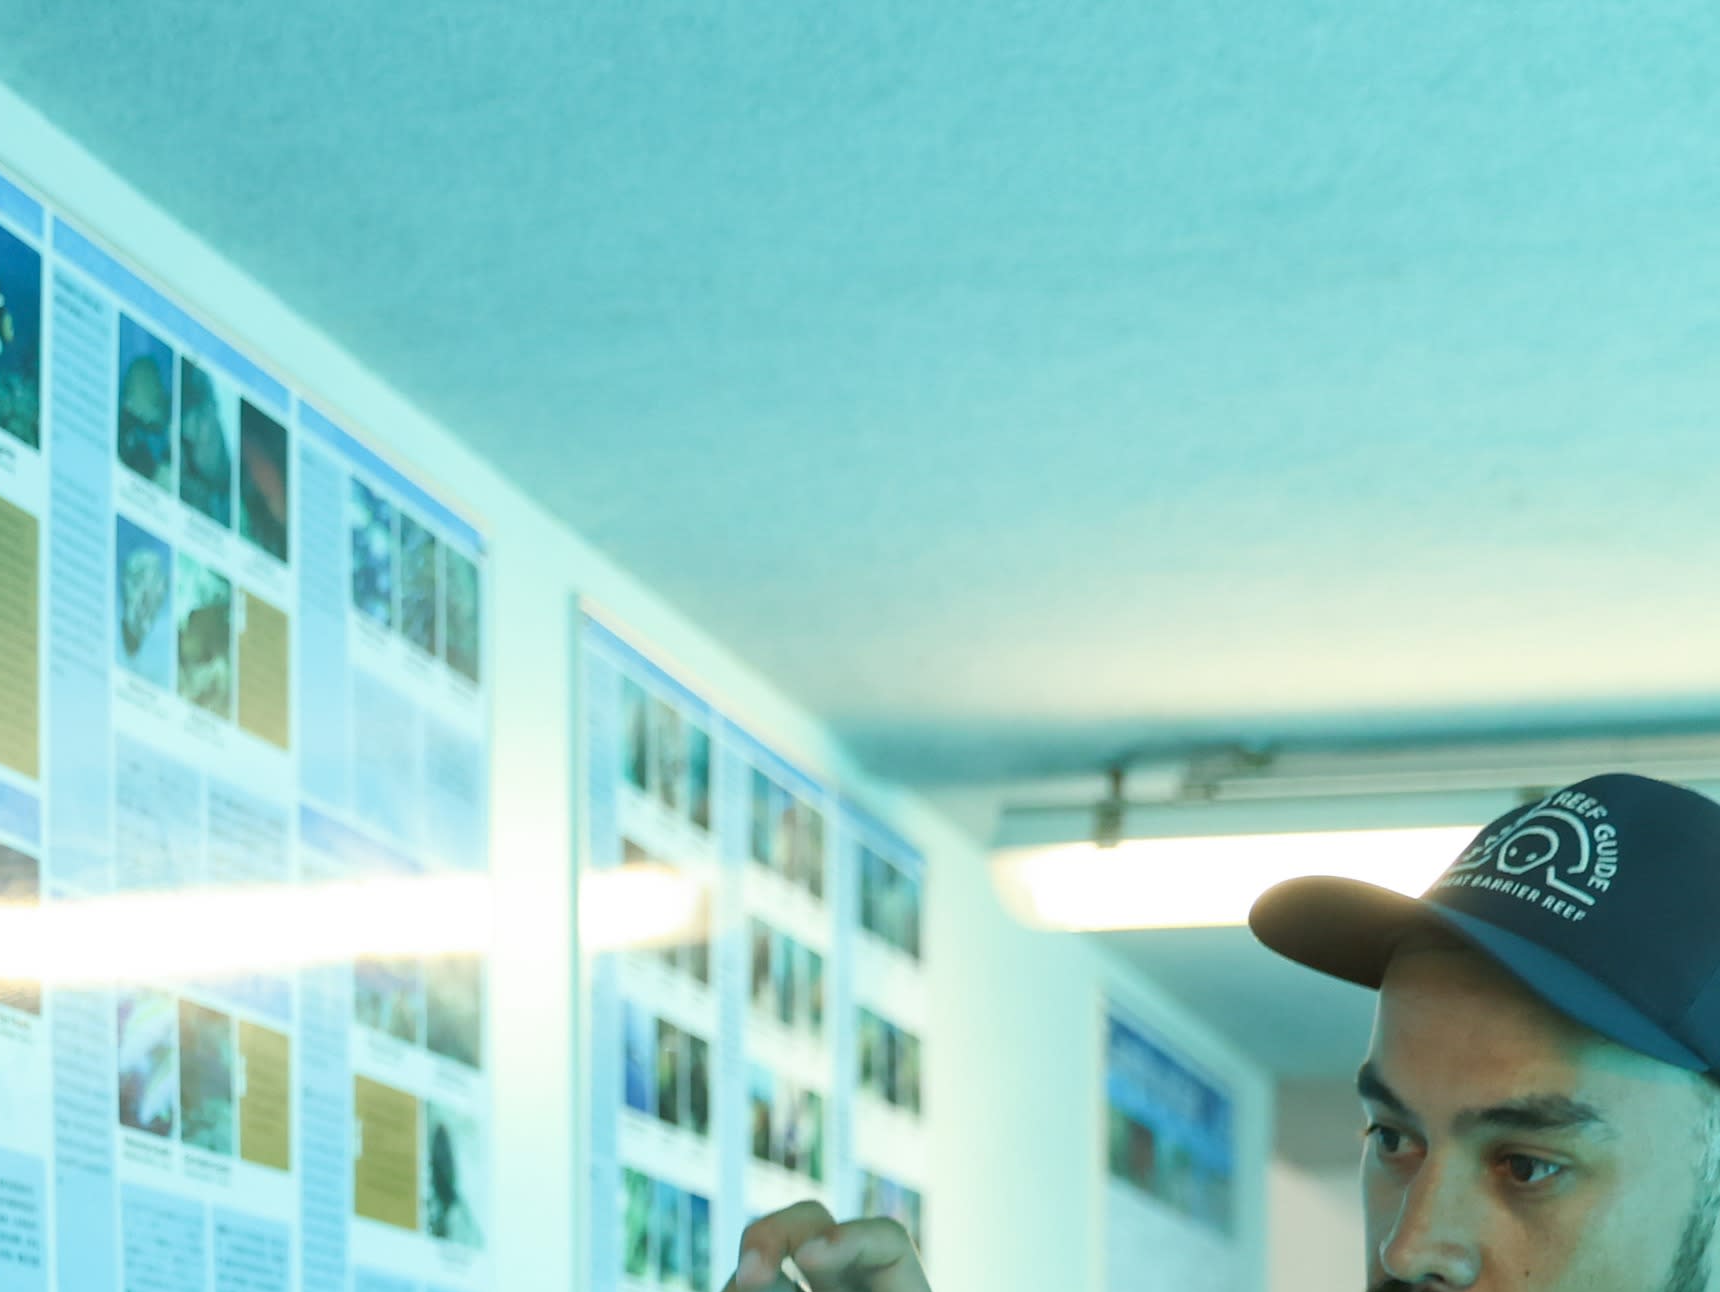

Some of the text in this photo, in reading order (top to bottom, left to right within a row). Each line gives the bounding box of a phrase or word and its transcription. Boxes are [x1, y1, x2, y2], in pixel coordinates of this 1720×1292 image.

[1552, 791, 1618, 893] REEF GUIDE
[1471, 875, 1541, 903] BARRIER
[1541, 895, 1587, 922] REEF
